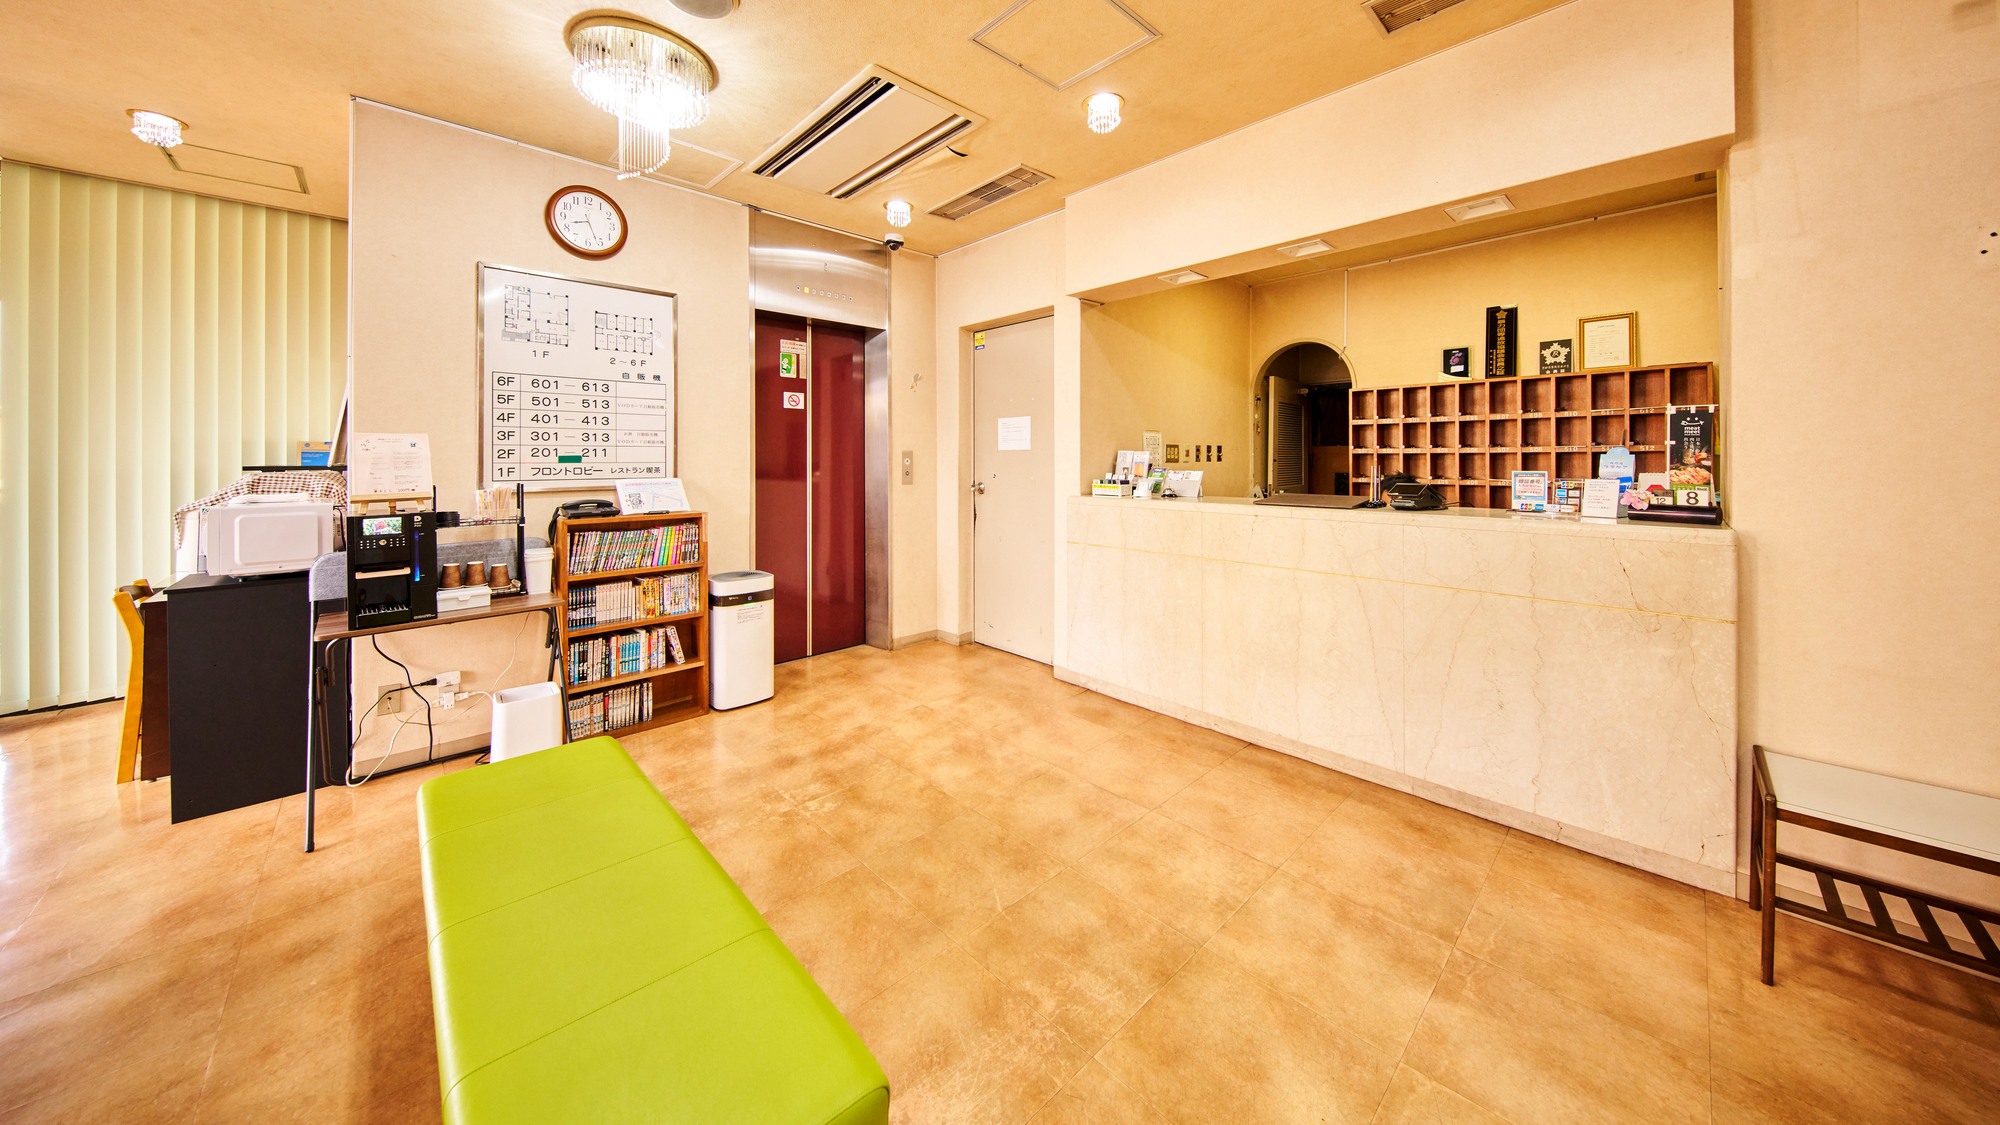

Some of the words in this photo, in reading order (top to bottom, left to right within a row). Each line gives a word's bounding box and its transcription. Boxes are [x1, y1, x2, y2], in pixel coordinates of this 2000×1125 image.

[573, 196, 579, 205] 11
[585, 196, 592, 205] 12
[563, 202, 571, 211] 10
[560, 212, 566, 220] 9
[606, 212, 611, 220] 2
[564, 223, 570, 232] 8
[609, 223, 615, 231] 3
[573, 233, 578, 241] 7
[585, 238, 591, 247] 6
[497, 376, 515, 386] 6F
[531, 379, 559, 390] 601
[582, 382, 610, 392] 613
[497, 394, 515, 405] 5F
[531, 397, 559, 407] 501
[582, 399, 610, 409] 513
[497, 413, 515, 422] 4F
[531, 414, 558, 424] 401
[582, 416, 610, 426] 413
[497, 431, 515, 441] 3F
[530, 431, 558, 441] 301
[582, 433, 610, 442] 313
[497, 449, 515, 459] 2F
[531, 448, 558, 457] 201
[582, 448, 607, 457] 211
[498, 468, 515, 477] 1F
[531, 467, 603, 476] フロントロビー
[1686, 491, 1699, 505] 8
